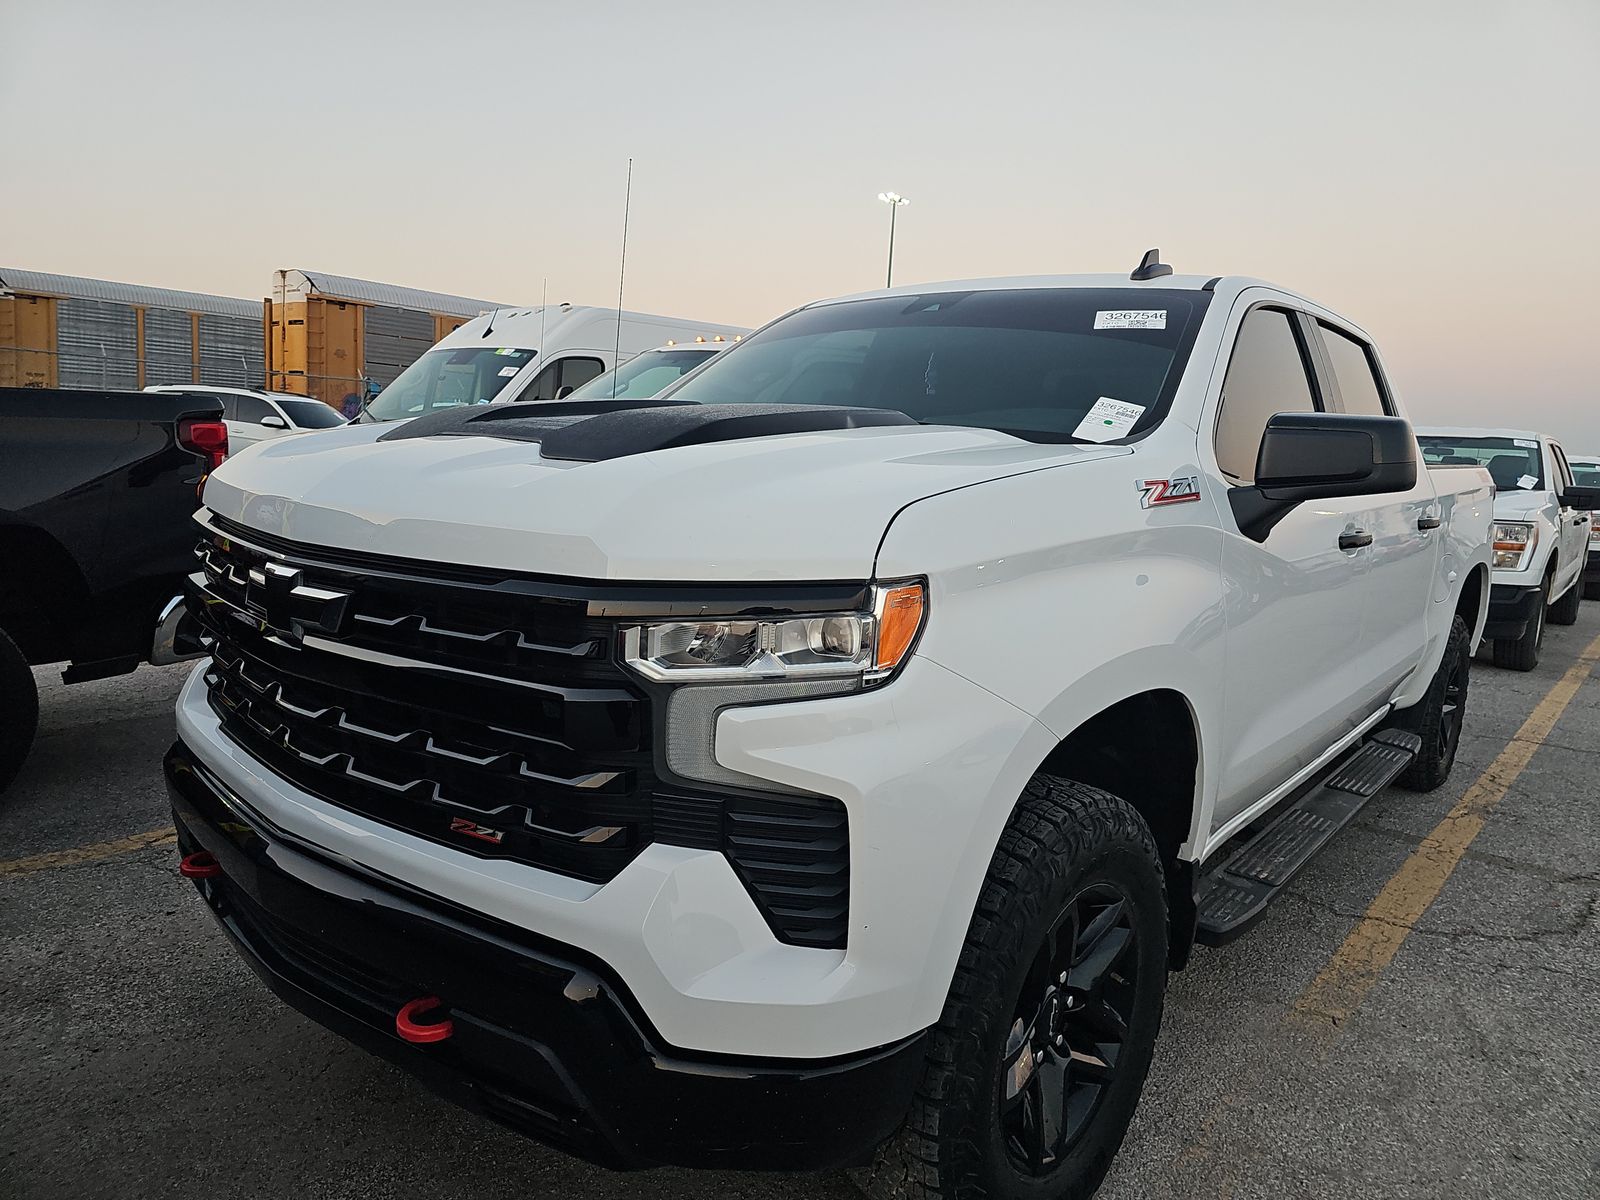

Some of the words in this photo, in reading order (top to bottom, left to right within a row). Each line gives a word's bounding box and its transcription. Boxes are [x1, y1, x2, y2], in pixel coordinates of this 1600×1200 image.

[1105, 312, 1167, 320] 3267546
[1097, 401, 1142, 416] 3267546
[1136, 476, 1201, 509] Z71
[450, 817, 505, 844] Z71
